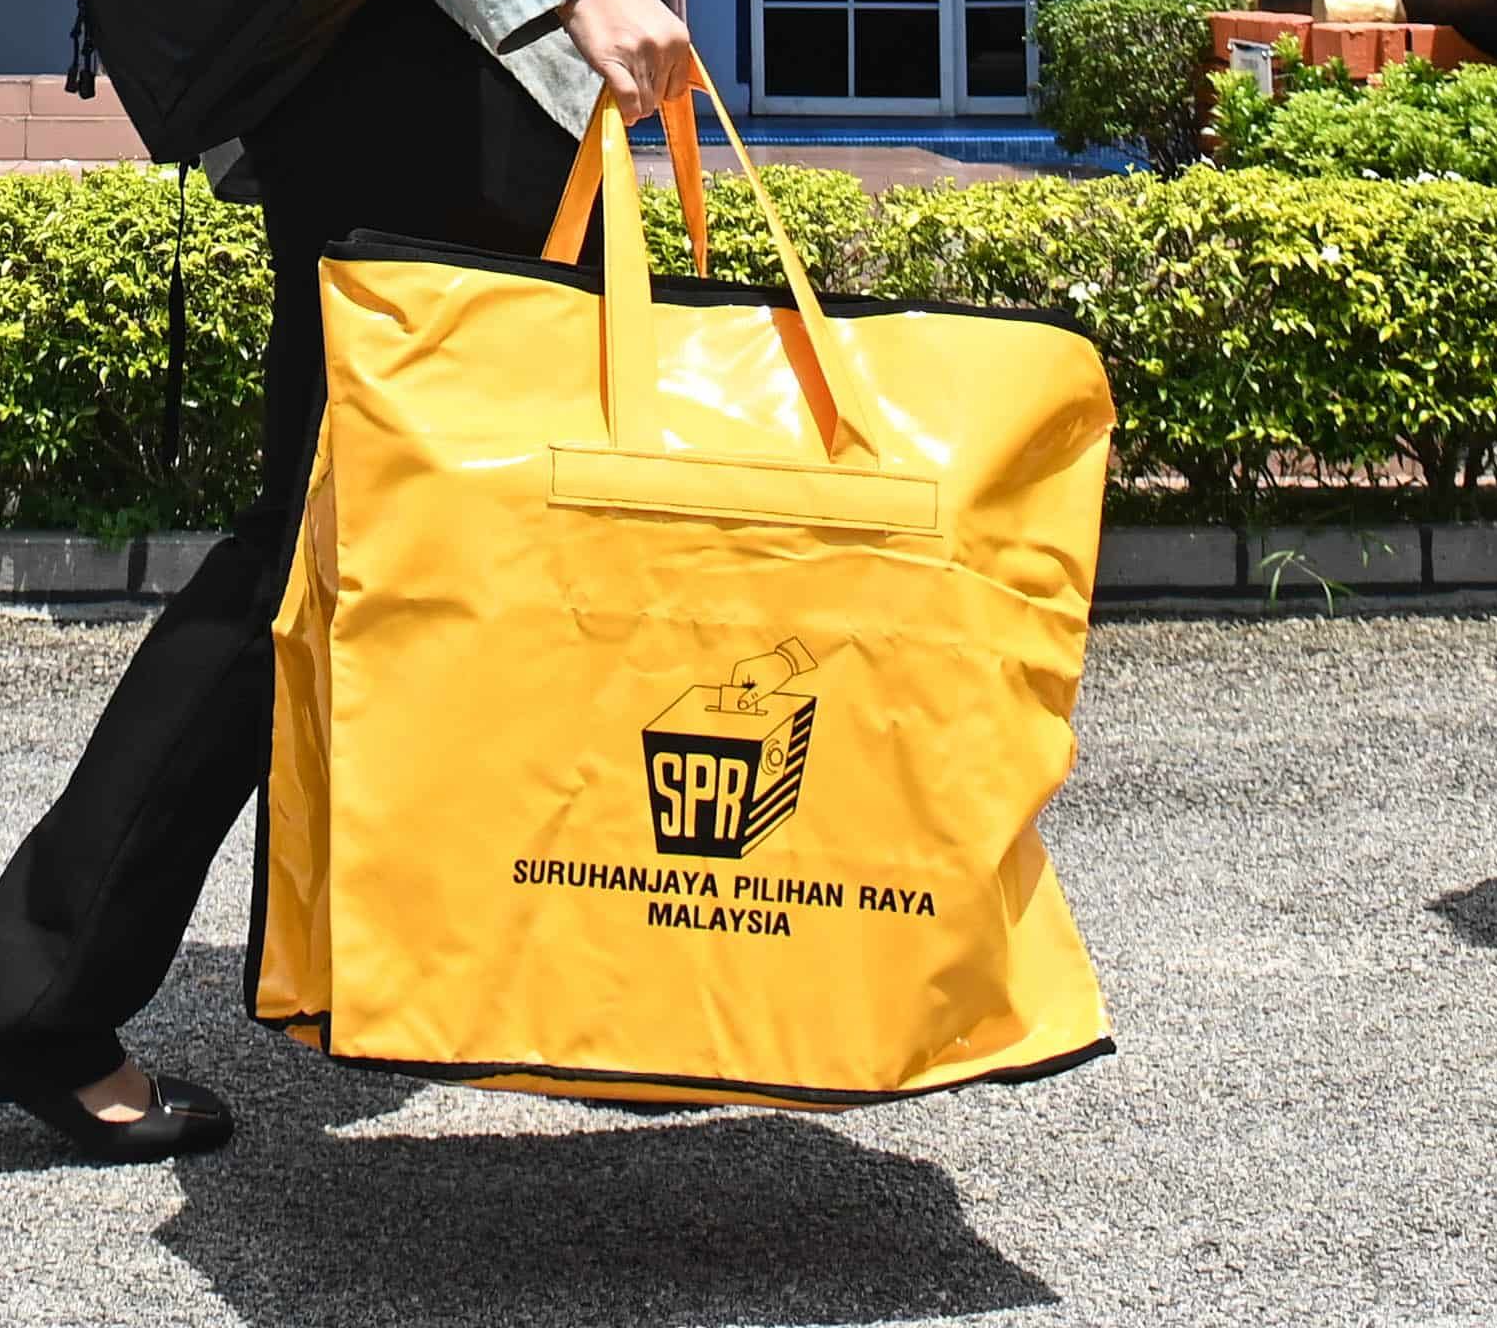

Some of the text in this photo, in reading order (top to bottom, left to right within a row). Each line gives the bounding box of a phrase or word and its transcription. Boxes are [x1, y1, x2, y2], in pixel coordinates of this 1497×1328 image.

[652, 751, 750, 842] SPR
[513, 858, 936, 917] SURUHANJAYA PILIHAN RAYA
[647, 902, 791, 937] MALAYSIA
